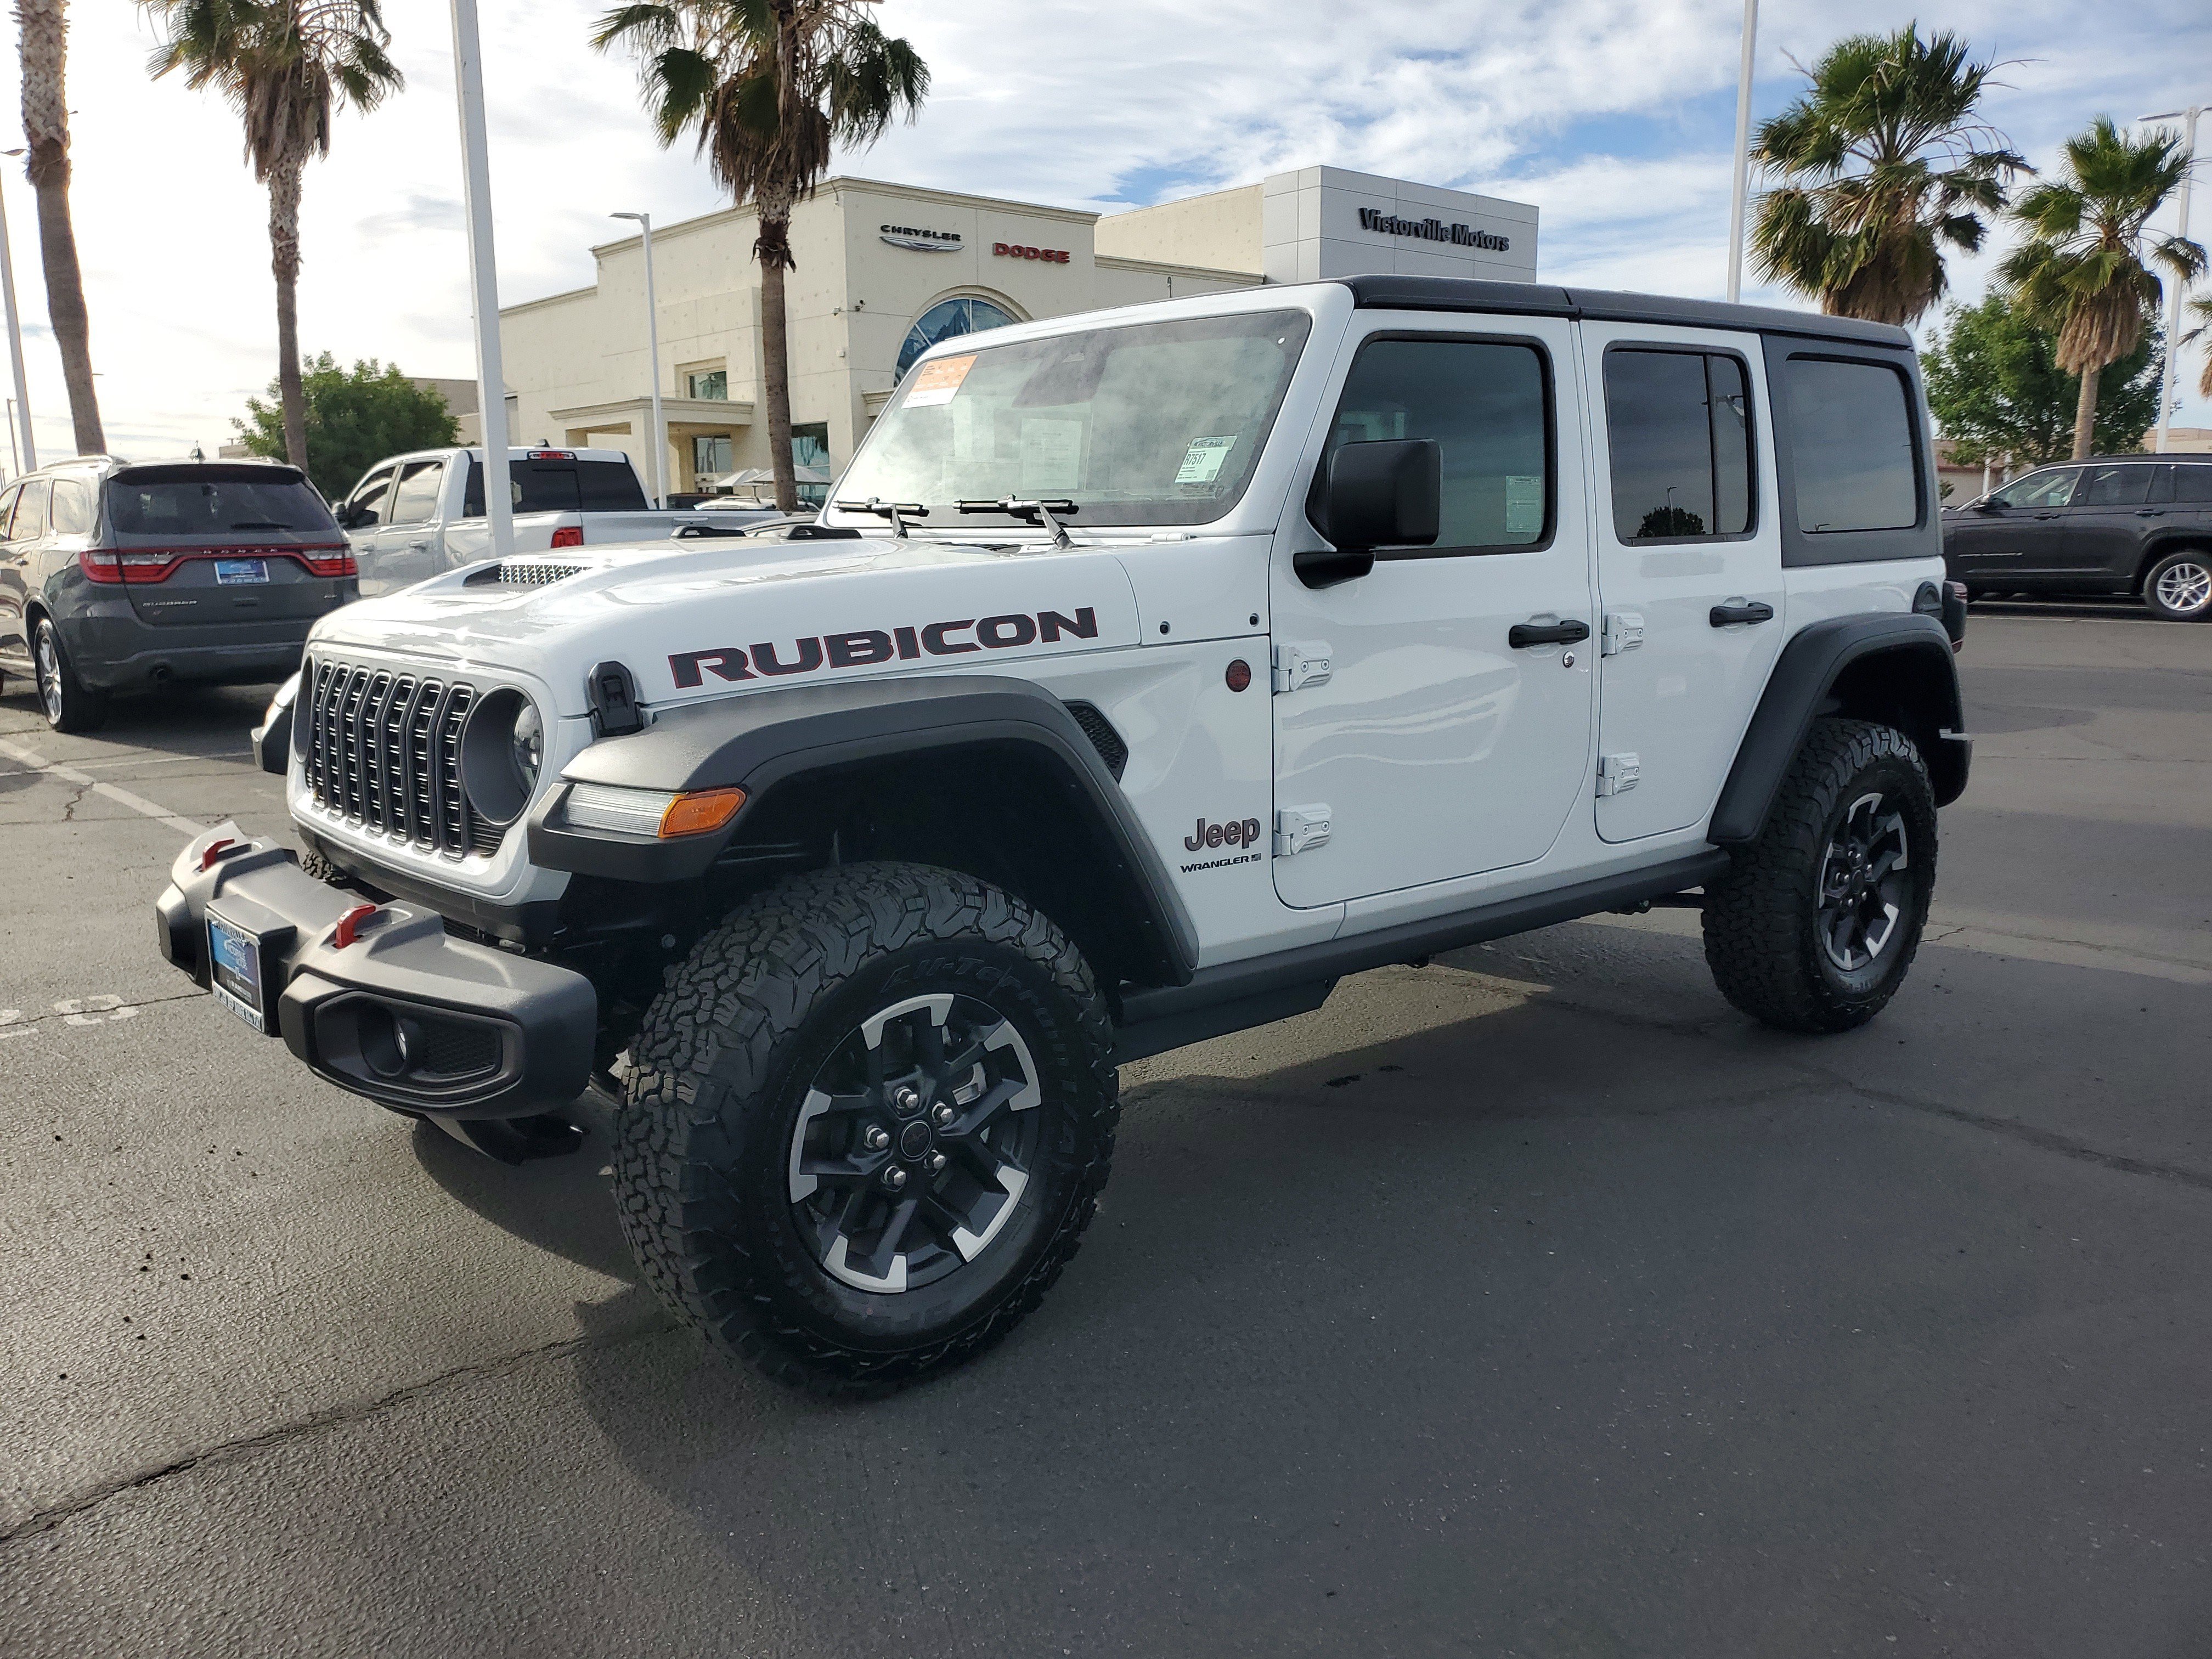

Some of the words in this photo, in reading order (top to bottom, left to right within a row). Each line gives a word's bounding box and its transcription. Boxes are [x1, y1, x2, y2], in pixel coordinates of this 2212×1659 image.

[881, 224, 962, 241] CHRYSLER
[1358, 207, 1450, 242] Victorville
[1450, 223, 1510, 252] Motors
[992, 242, 1070, 264] DODGE
[1183, 453, 1207, 466] R7517
[667, 607, 1099, 689] RUBICON
[1184, 817, 1261, 851] Jeep
[1180, 855, 1250, 873] WRANGLER
